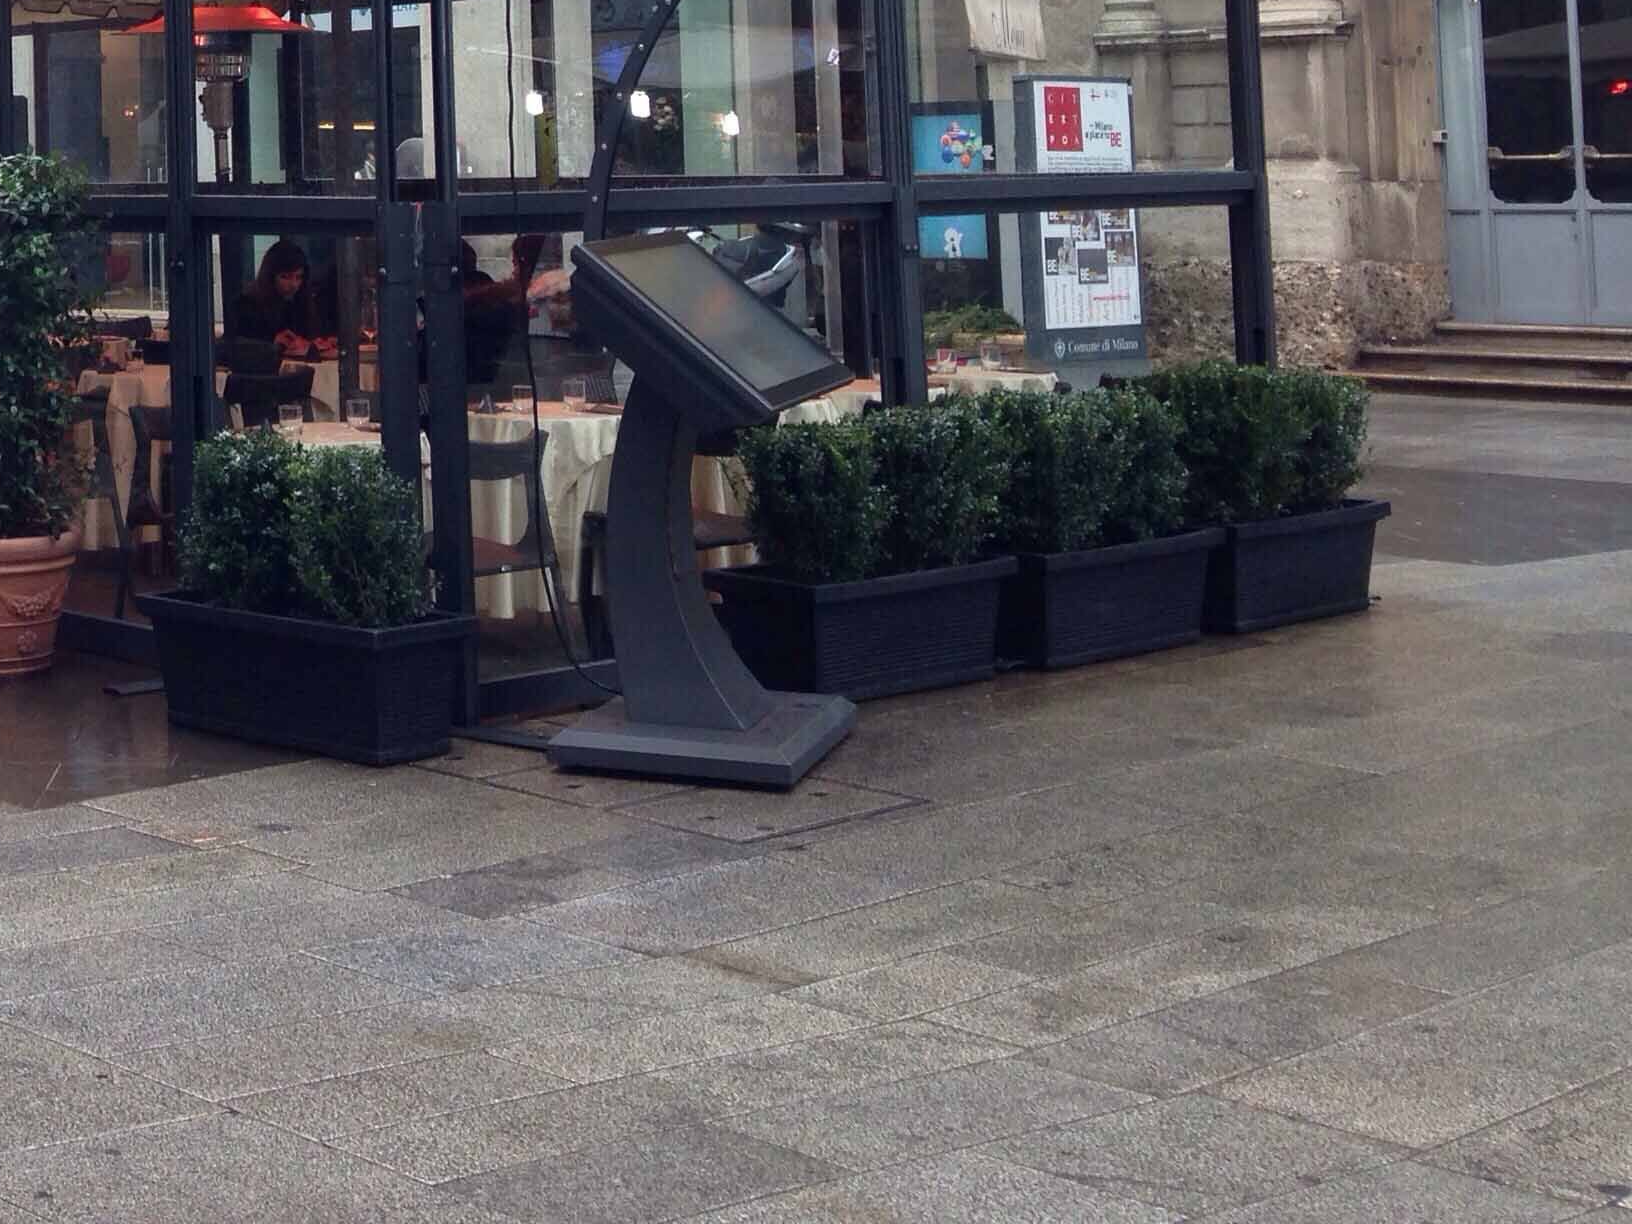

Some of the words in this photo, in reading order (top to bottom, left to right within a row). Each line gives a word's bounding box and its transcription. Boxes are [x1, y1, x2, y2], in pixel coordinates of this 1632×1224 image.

[1068, 340, 1099, 353] Comune
[1101, 337, 1111, 353] di
[1111, 336, 1139, 352] Milano
